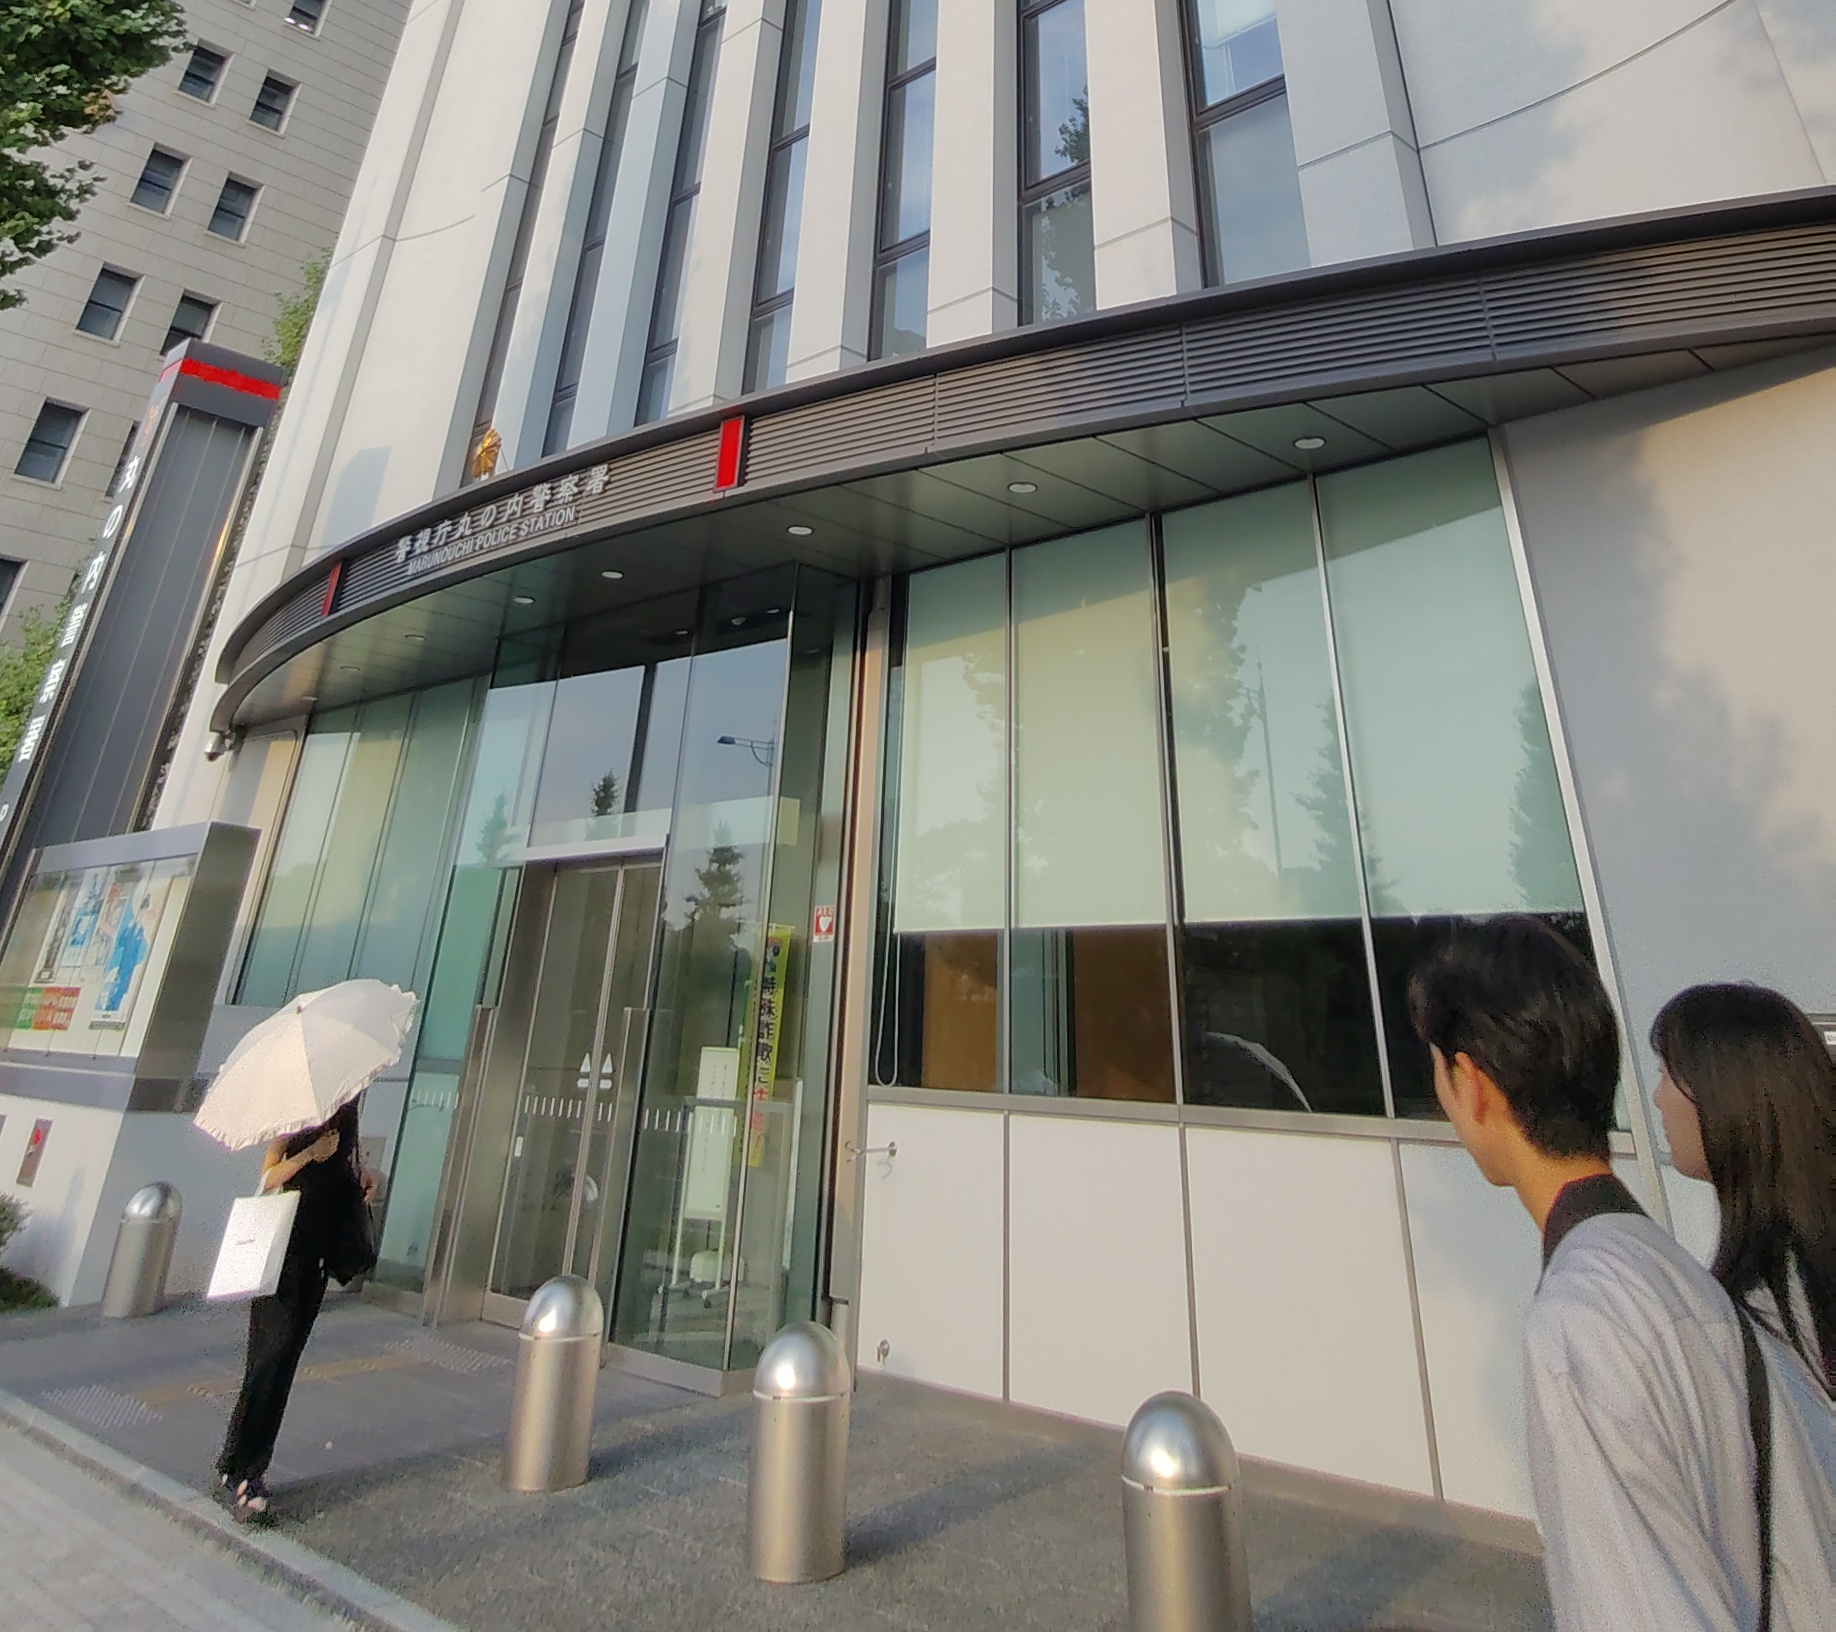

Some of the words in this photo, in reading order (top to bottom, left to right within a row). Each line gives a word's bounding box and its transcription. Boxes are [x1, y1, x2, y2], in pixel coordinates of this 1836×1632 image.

[395, 463, 610, 563] 警視庁丸の内警察署
[407, 538, 474, 575] MARUNOUCHI
[475, 525, 517, 551] POLICE
[520, 506, 576, 537] STATION
[18, 455, 140, 762] 丸の内警察署
[816, 907, 833, 916] AED
